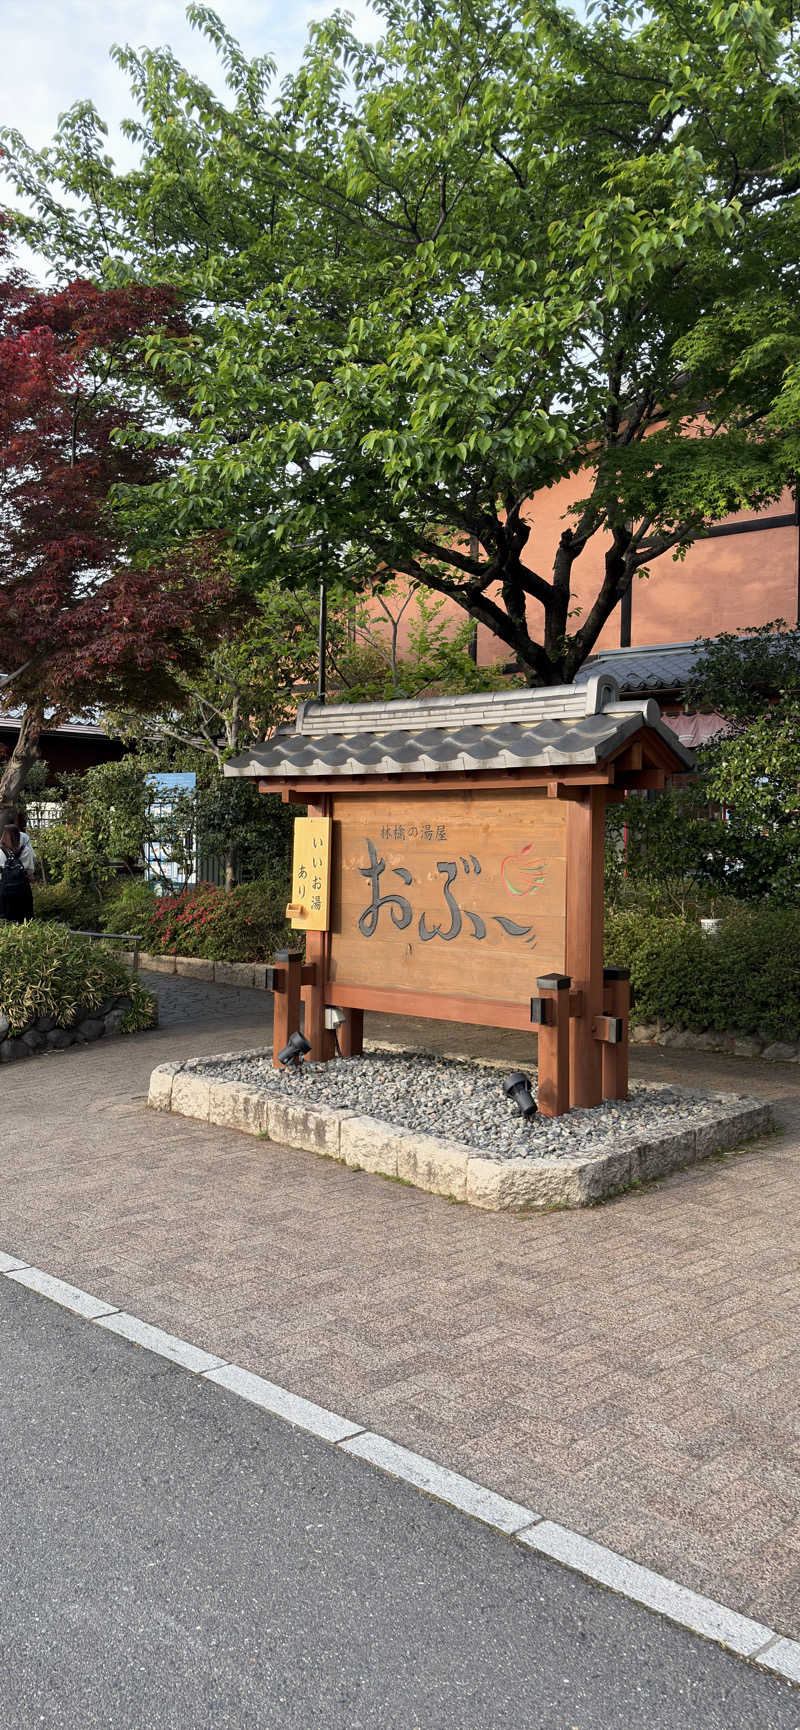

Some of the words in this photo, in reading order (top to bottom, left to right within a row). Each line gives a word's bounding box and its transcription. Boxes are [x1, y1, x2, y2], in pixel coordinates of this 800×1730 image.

[380, 824, 448, 841] 林檎の湯屋
[297, 864, 308, 899] あり
[310, 836, 324, 911] いいお湯
